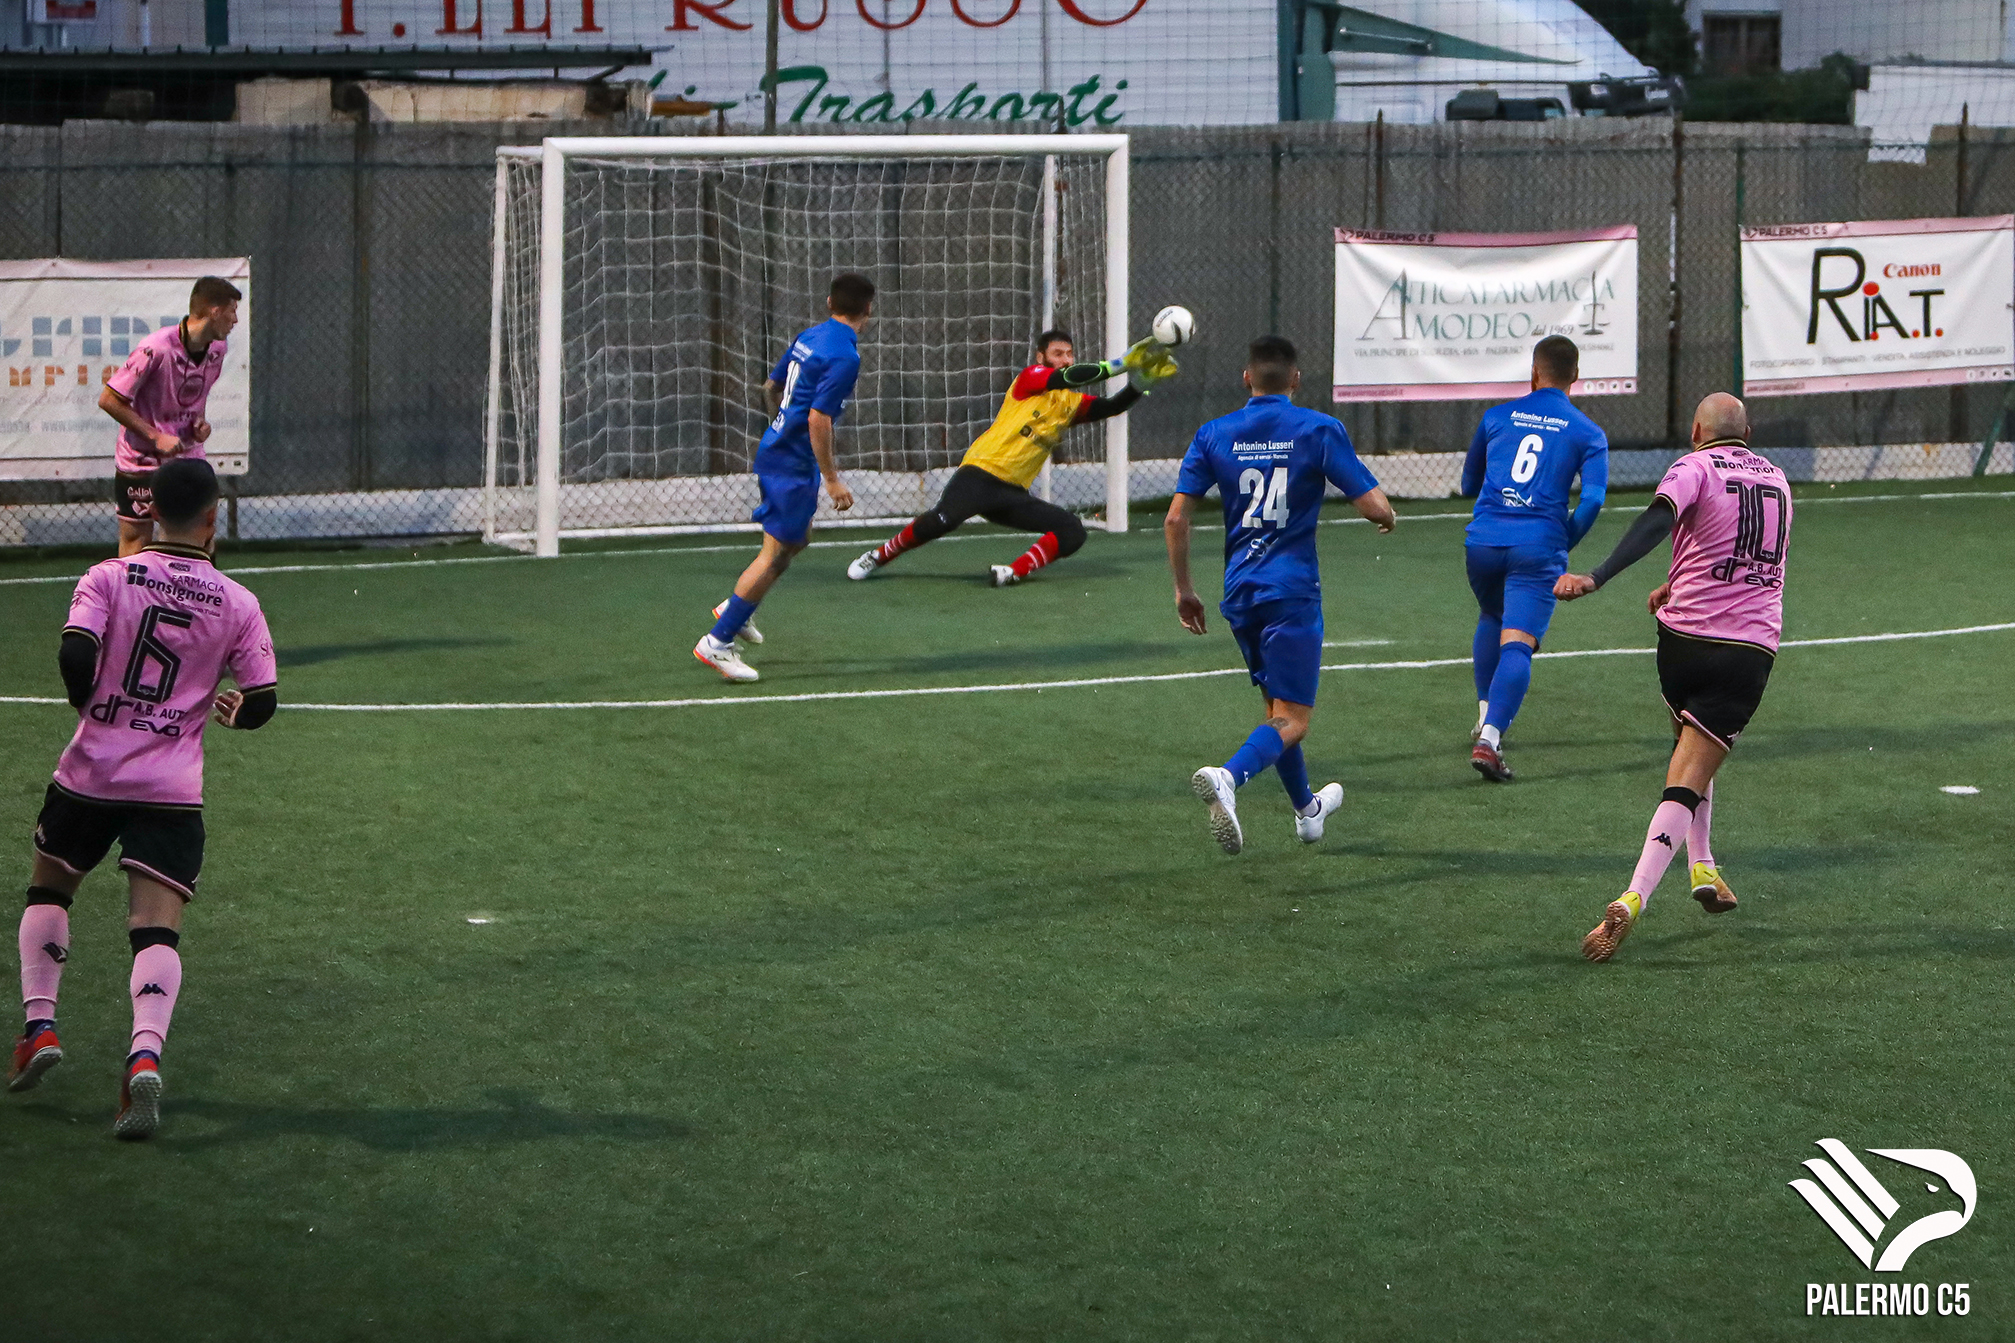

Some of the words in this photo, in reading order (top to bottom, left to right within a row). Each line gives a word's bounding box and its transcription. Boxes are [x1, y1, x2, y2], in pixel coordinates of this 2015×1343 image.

[1356, 231, 1415, 242] PALERMO
[1759, 226, 1810, 237] PALERMO
[1883, 262, 1941, 278] Canon
[1511, 410, 1543, 422] Antonino
[1233, 441, 1267, 452] Antonino
[1268, 440, 1294, 450] Lusseri
[1511, 434, 1544, 484] 6
[1239, 467, 1290, 530] 24
[1726, 480, 1787, 566] 10
[171, 574, 225, 594] FARMACIA
[1745, 573, 1783, 590] EVO
[122, 604, 194, 704] 6
[134, 702, 156, 717] A.B.
[129, 718, 180, 737] EVO
